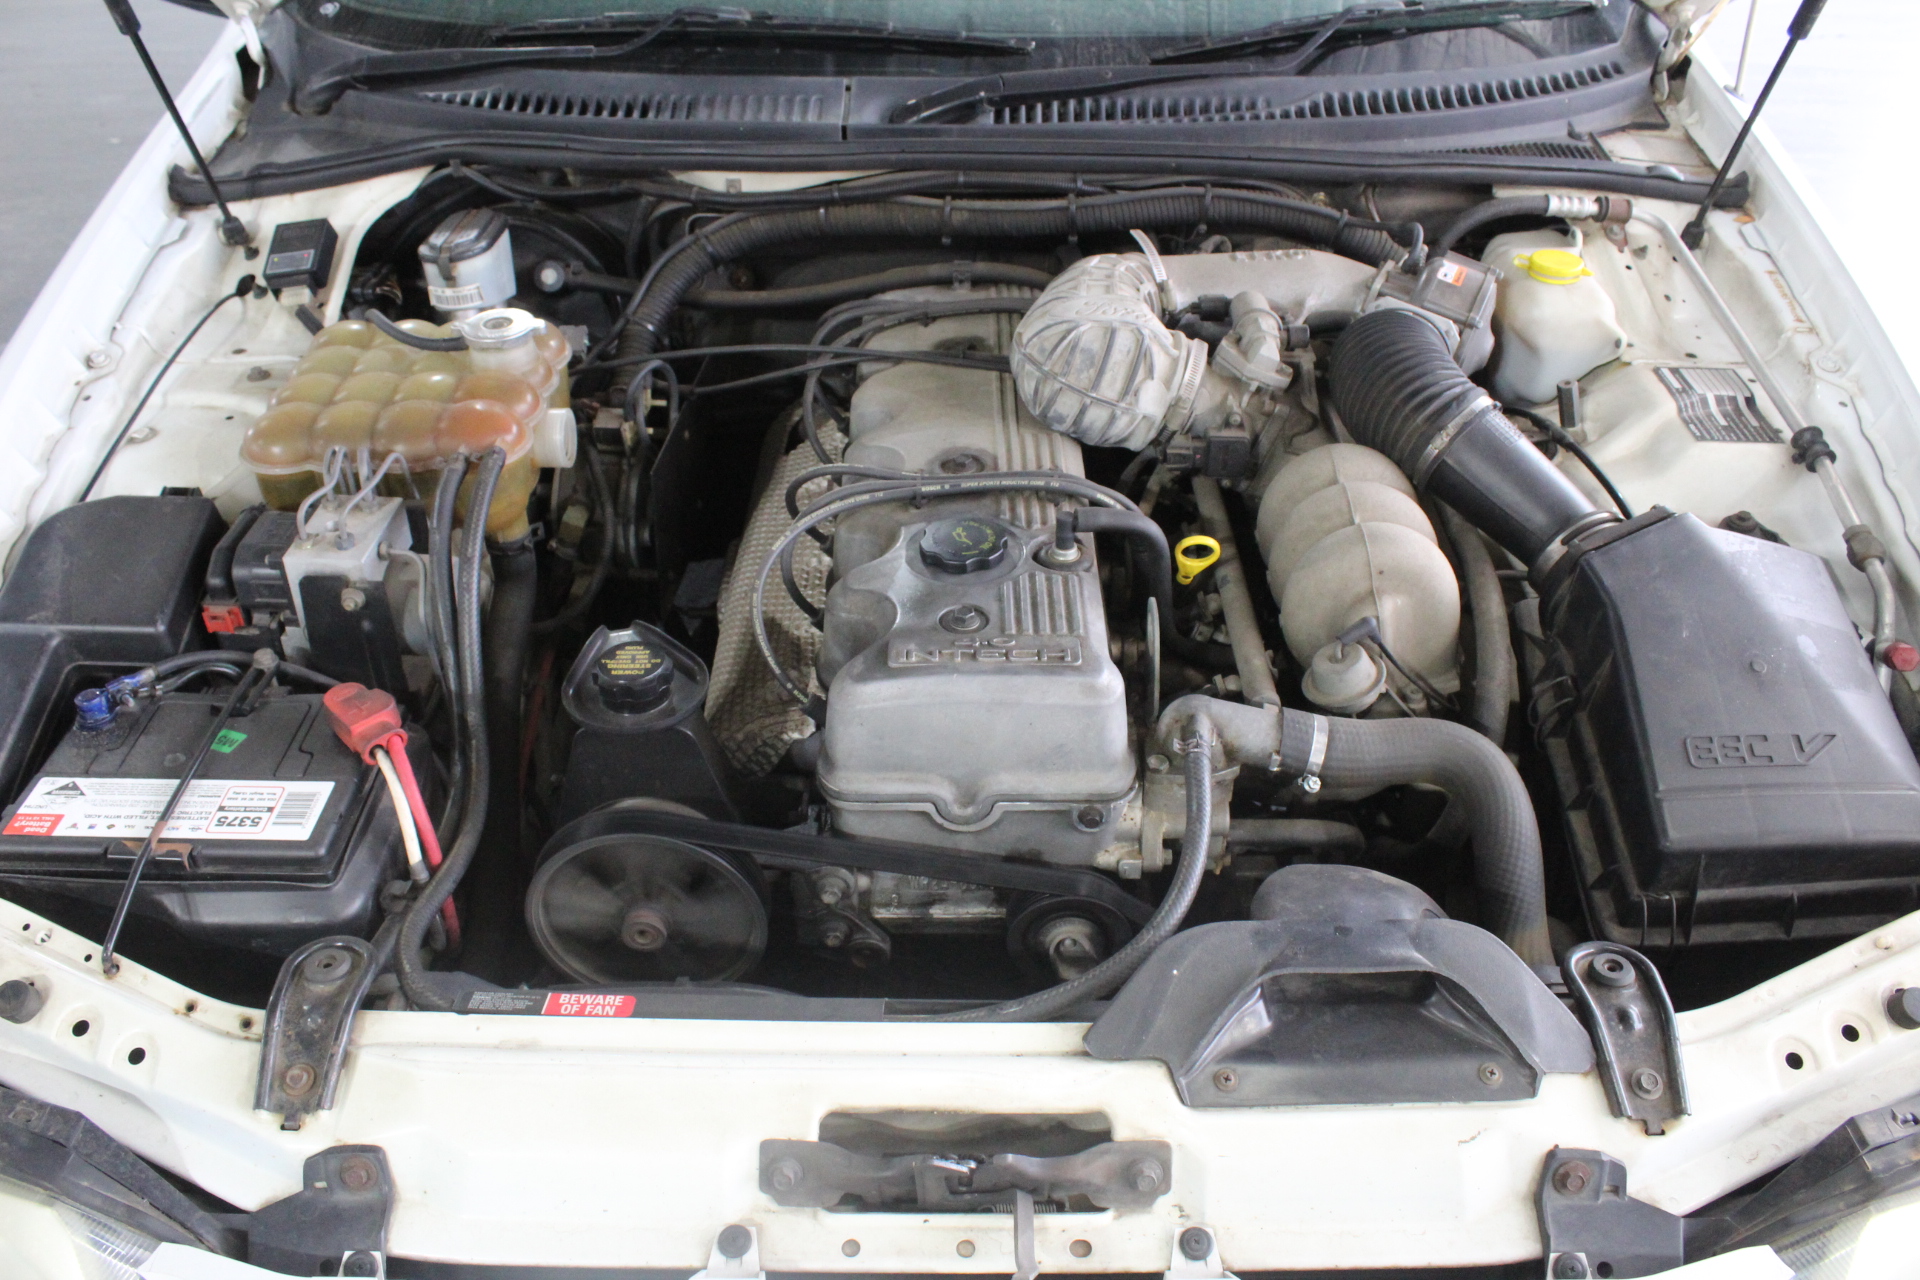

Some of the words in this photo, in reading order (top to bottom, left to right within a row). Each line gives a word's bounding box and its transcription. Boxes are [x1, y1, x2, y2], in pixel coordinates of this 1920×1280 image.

[953, 637, 1017, 647] 4.0
[898, 648, 1072, 662] INTECH
[793, 689, 808, 703] OSCH
[1684, 734, 1775, 769] EEC
[1791, 733, 1838, 766] V
[13, 820, 52, 828] Battery?
[214, 815, 263, 827] 5375
[23, 826, 48, 834] Dead
[558, 993, 625, 1006] BEWARE
[560, 1004, 582, 1015] OF
[584, 1004, 617, 1016] FAN
